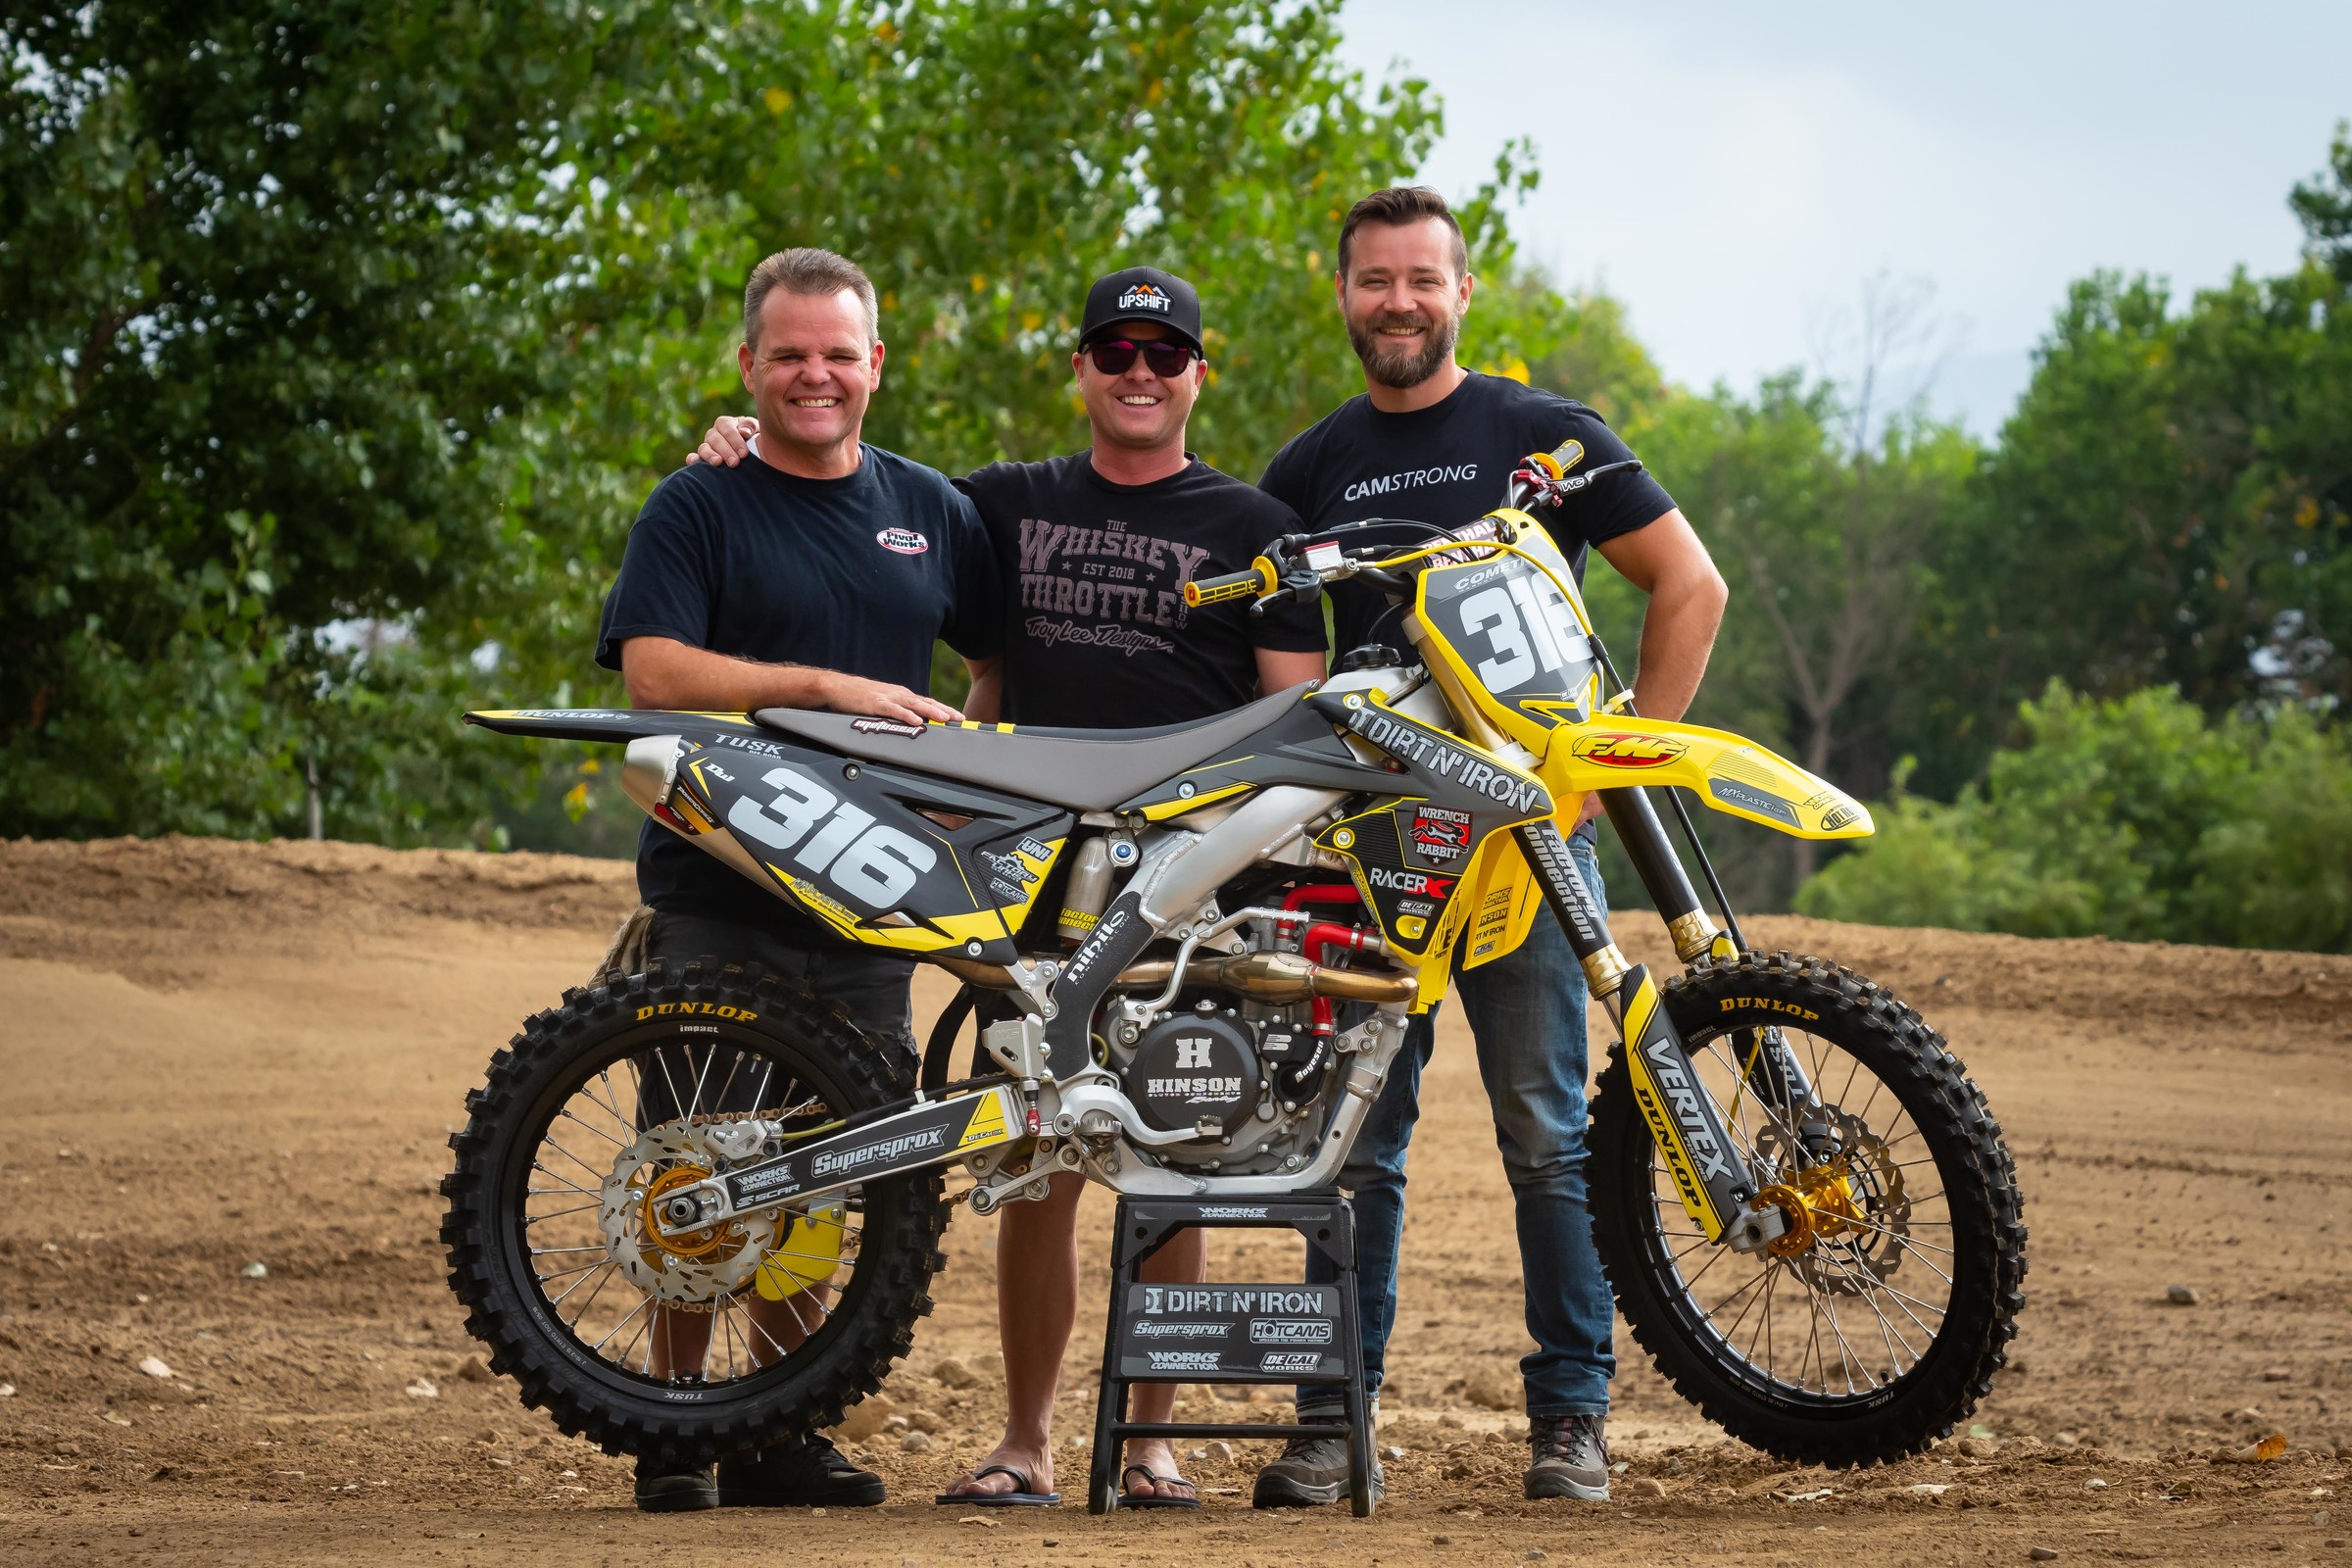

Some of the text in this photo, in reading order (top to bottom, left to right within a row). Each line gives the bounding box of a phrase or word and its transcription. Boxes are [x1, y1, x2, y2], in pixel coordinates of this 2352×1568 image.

[1118, 294, 1171, 312] UPSHIFT
[1344, 464, 1478, 502] CAMSTRONG
[1106, 519, 1127, 532] THE
[882, 538, 925, 549] Works
[886, 531, 919, 542] Pivot
[1018, 518, 1210, 595] WHISKEY
[1082, 563, 1136, 580] EST 2018
[1453, 556, 1532, 591] COMETI
[1020, 573, 1177, 628] THROTTLE
[1025, 615, 1175, 658] Troy Lee Designs
[1458, 566, 1594, 694] 316
[514, 710, 616, 719] DUNLOP
[714, 733, 785, 756] TUSK
[1571, 736, 1690, 760] FMF
[1367, 716, 1437, 763] DIRT
[1457, 760, 1540, 815] IRON
[1418, 806, 1470, 824] WRENCH
[727, 767, 938, 909] 316
[1021, 838, 1052, 860] UNI
[1415, 842, 1460, 860] RABBIT
[1484, 887, 1513, 905] ORKS
[1061, 907, 1102, 923] Factor
[1479, 909, 1508, 925] NSON
[1067, 909, 1125, 983] nihilo
[635, 1002, 759, 1022] DUNLOP
[1720, 997, 1820, 1022] DUNLOP
[679, 1024, 720, 1034] impact
[1688, 1024, 1716, 1043] impact
[1175, 1037, 1213, 1069] H
[1295, 1040, 1324, 1084] Boyesen
[1147, 1077, 1242, 1094] HINSON
[1645, 1037, 1735, 1180] VERTEX
[812, 1128, 944, 1176] Supersprox
[1635, 1087, 1702, 1208] DUNLOP
[1683, 1135, 1709, 1184] PISTONS
[736, 1163, 791, 1186] WORKS
[741, 1175, 793, 1193] CONNECTION
[1167, 1291, 1229, 1313] DIRT
[1259, 1292, 1323, 1314] IRON
[1133, 1320, 1230, 1339] Supersprox
[1252, 1320, 1330, 1339] HOTCAMS
[1147, 1351, 1222, 1362] WORKS
[1150, 1361, 1221, 1371] CONNECTION
[1265, 1353, 1319, 1365] DECAL
[663, 1391, 704, 1401] TUSK
[1868, 1392, 1895, 1409] TUSK
